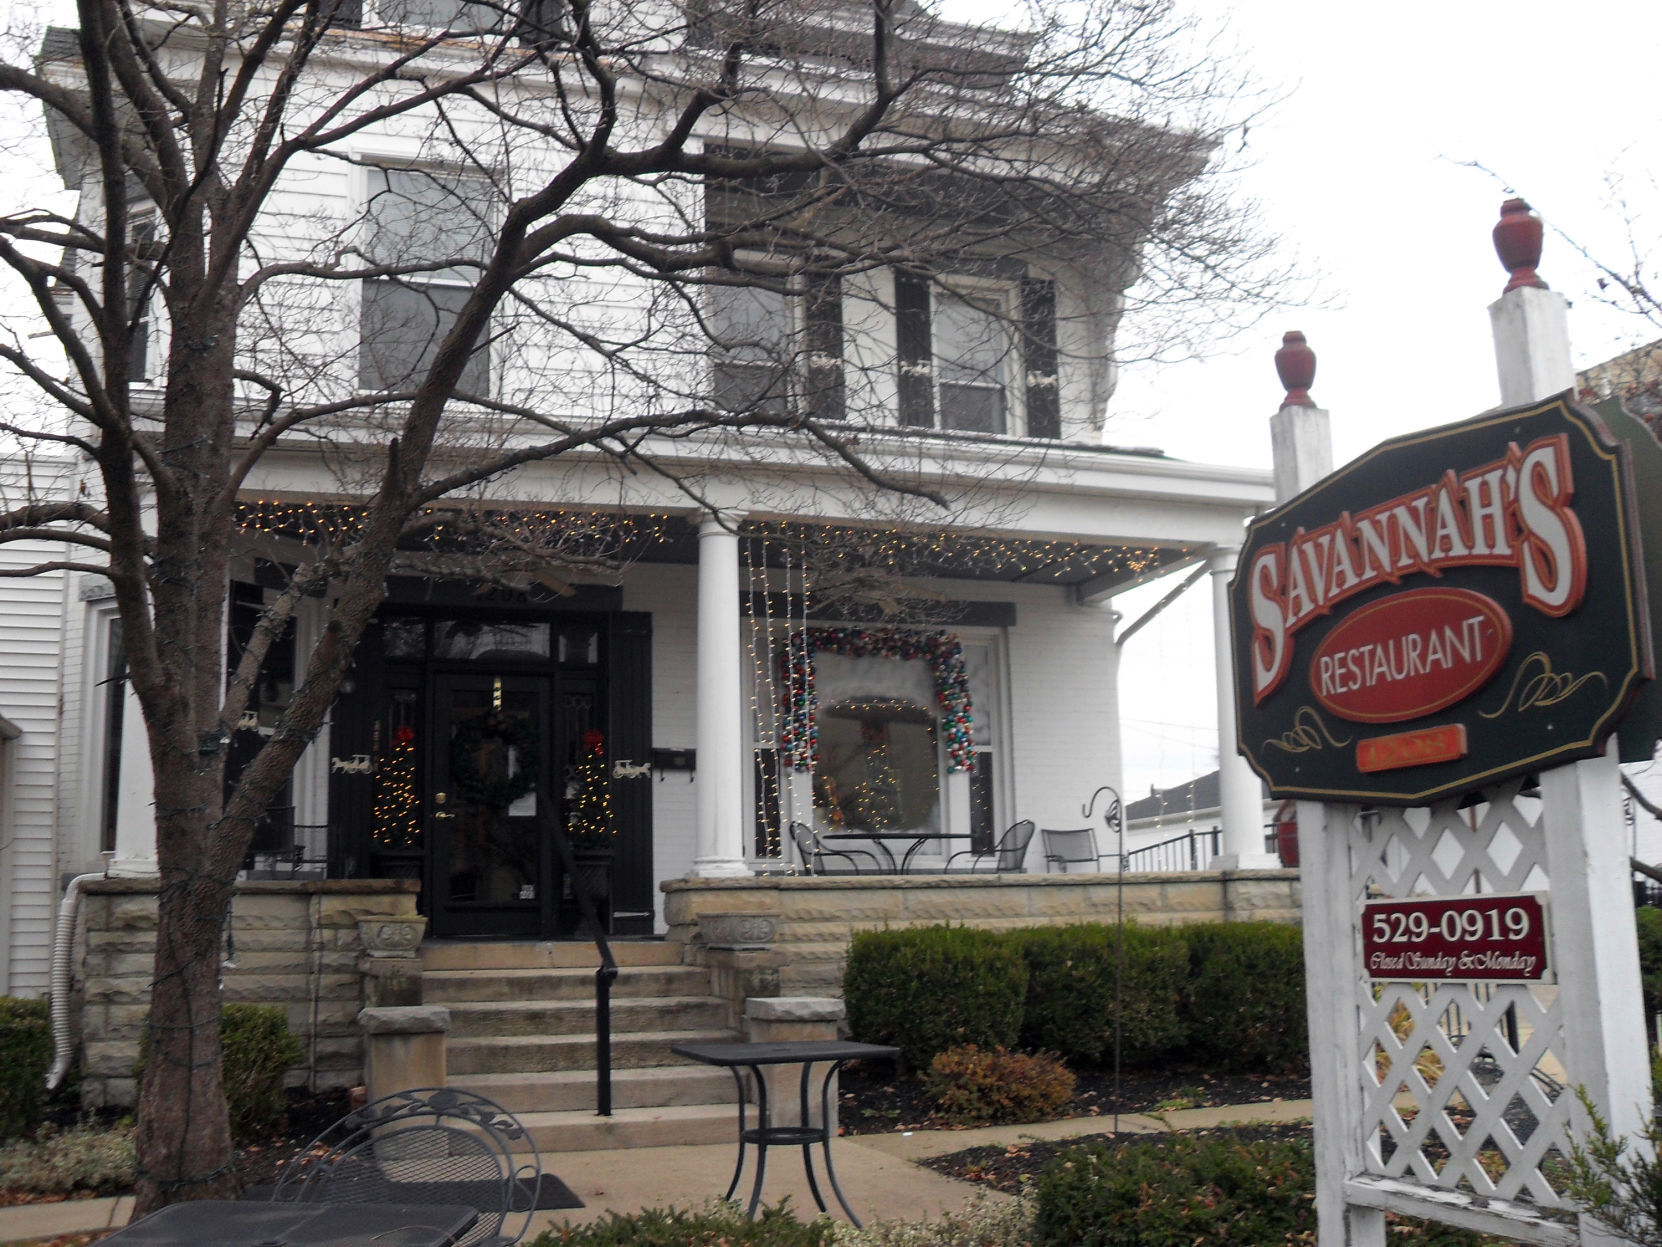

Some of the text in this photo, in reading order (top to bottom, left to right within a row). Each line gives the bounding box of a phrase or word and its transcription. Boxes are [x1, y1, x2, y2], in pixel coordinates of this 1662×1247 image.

[1252, 446, 1573, 692] SAVANNAH'S
[1319, 615, 1485, 696] RESTAURANT
[1372, 907, 1530, 943] 529-0919
[1369, 950, 1537, 977] Closed Sunday & Monday
